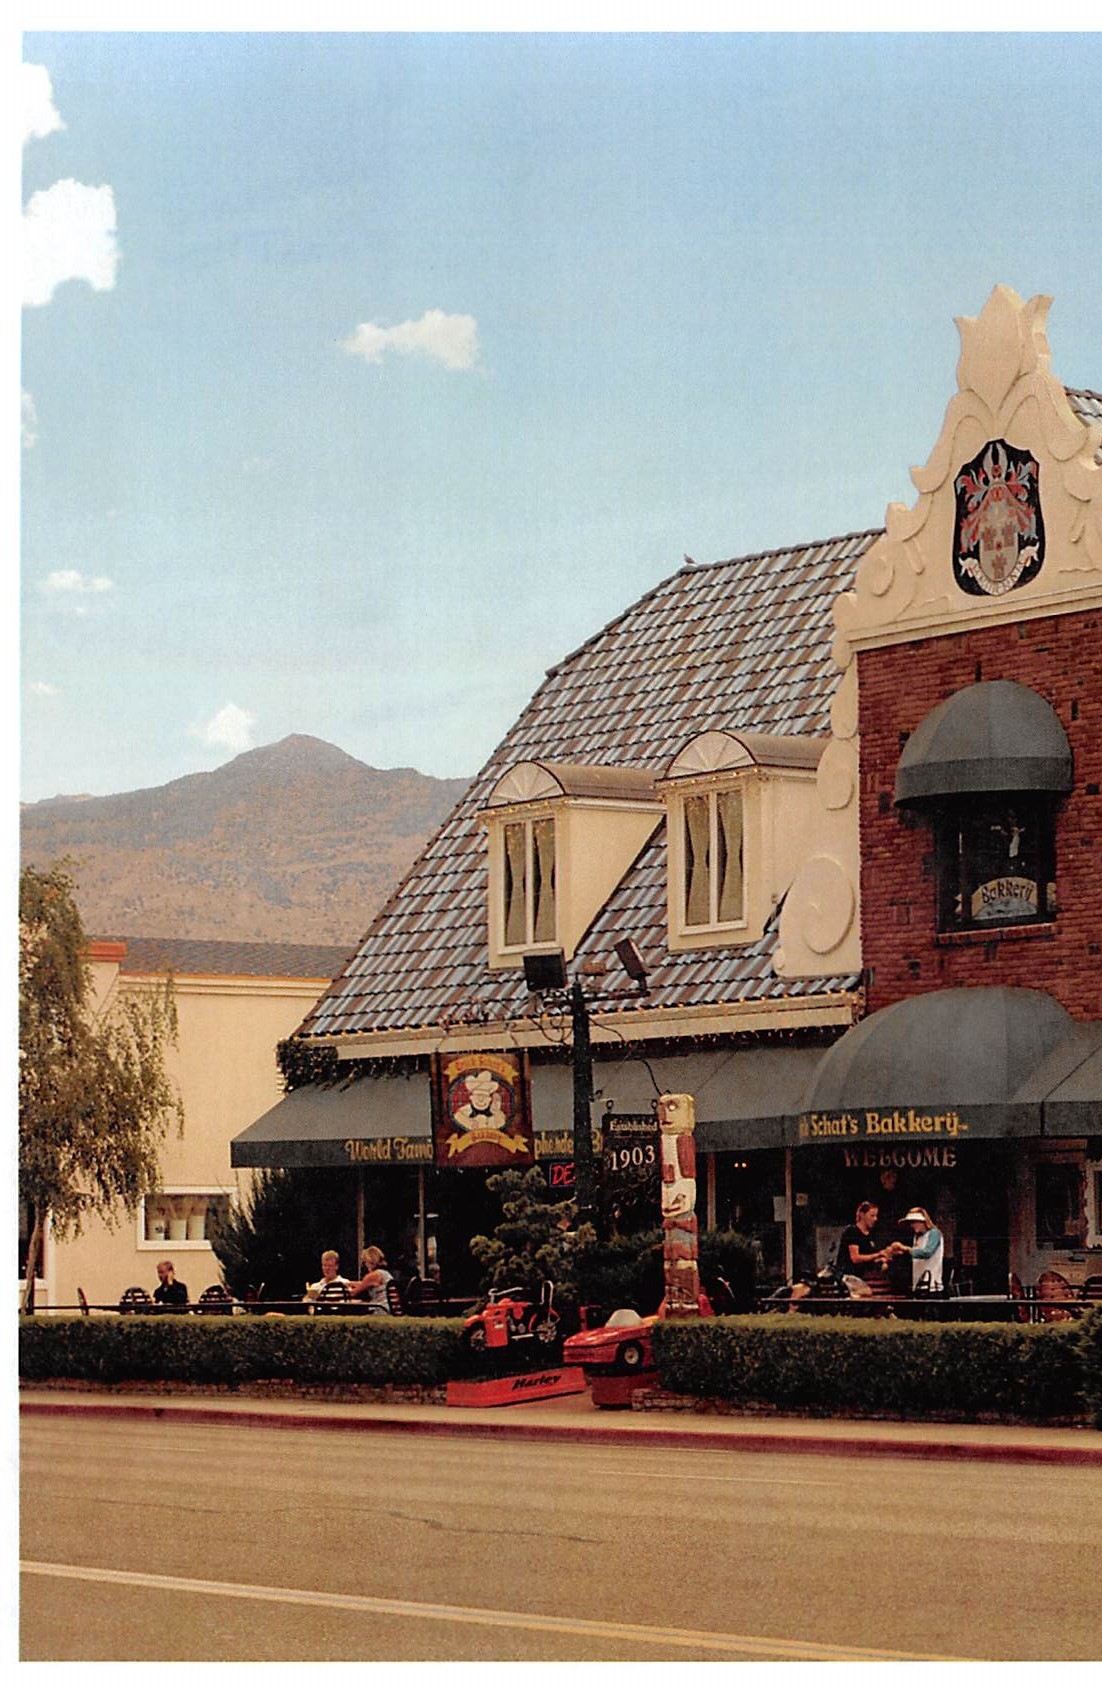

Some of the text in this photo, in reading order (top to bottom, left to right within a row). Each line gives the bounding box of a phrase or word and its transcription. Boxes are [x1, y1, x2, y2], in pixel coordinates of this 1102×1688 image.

[610, 1118, 658, 1132] Established
[811, 1113, 859, 1137] Schat's
[344, 1138, 391, 1161] World
[611, 1144, 656, 1171] 1903
[844, 1147, 957, 1168] WELCOME
[512, 1375, 562, 1391] Harley
